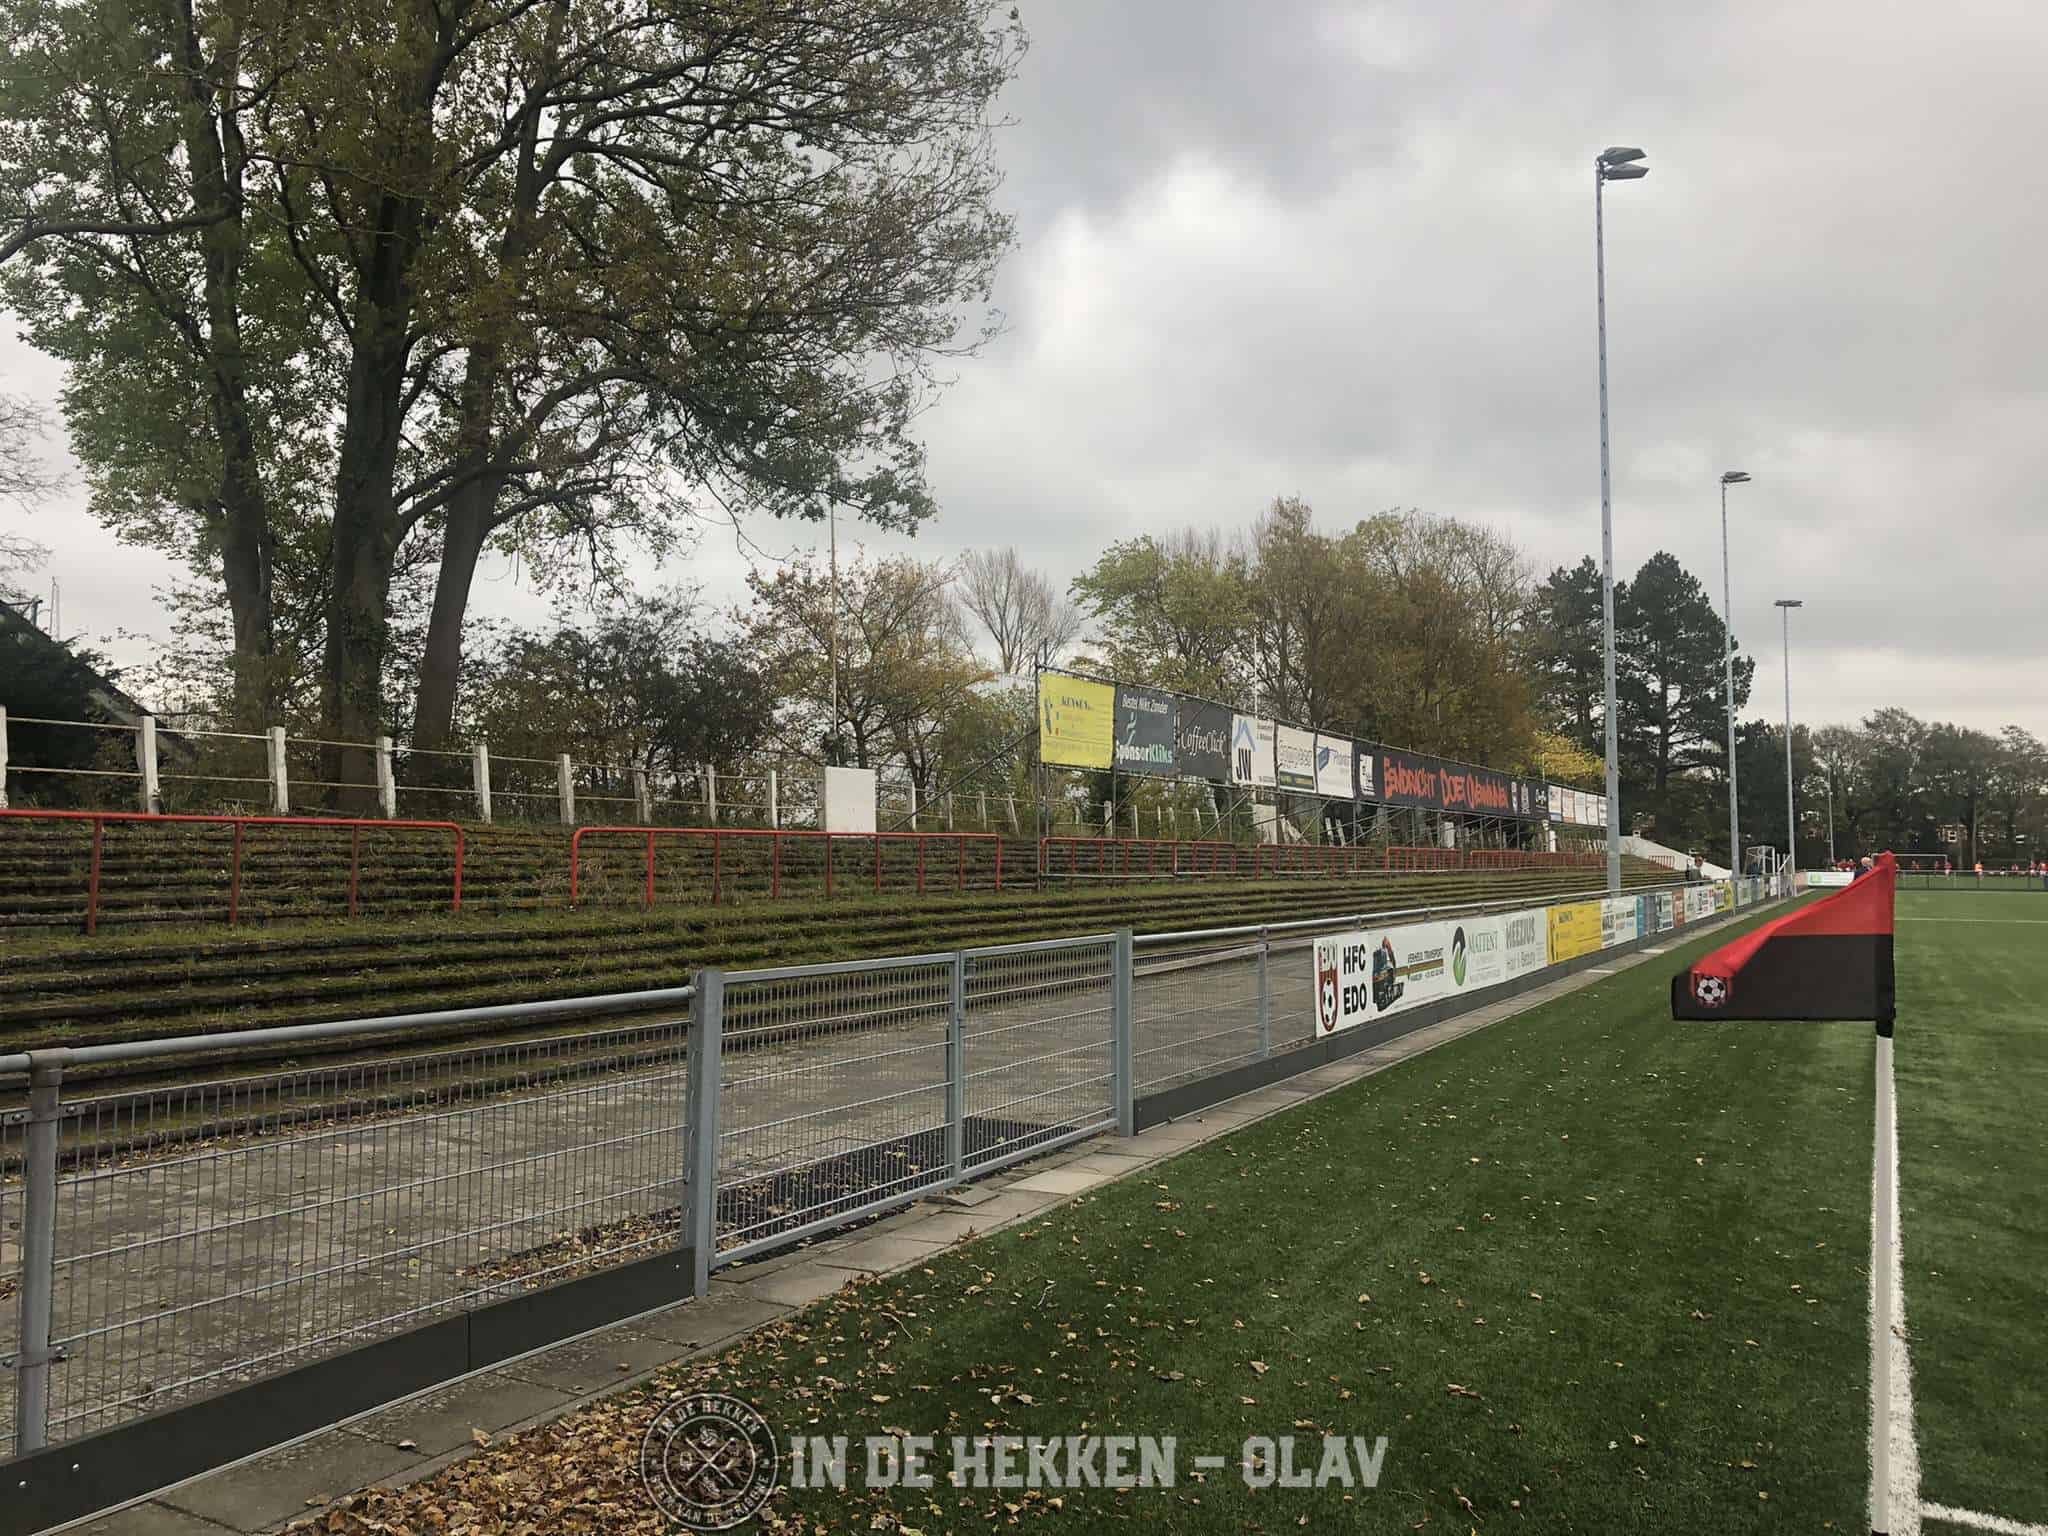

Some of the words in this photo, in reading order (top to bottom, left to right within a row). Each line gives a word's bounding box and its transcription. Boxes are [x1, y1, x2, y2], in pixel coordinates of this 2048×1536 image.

[1115, 739, 1172, 765] SponsorKliks
[1235, 747, 1252, 781] JW
[1343, 944, 1366, 975] HFC
[1343, 982, 1367, 1015] EDO
